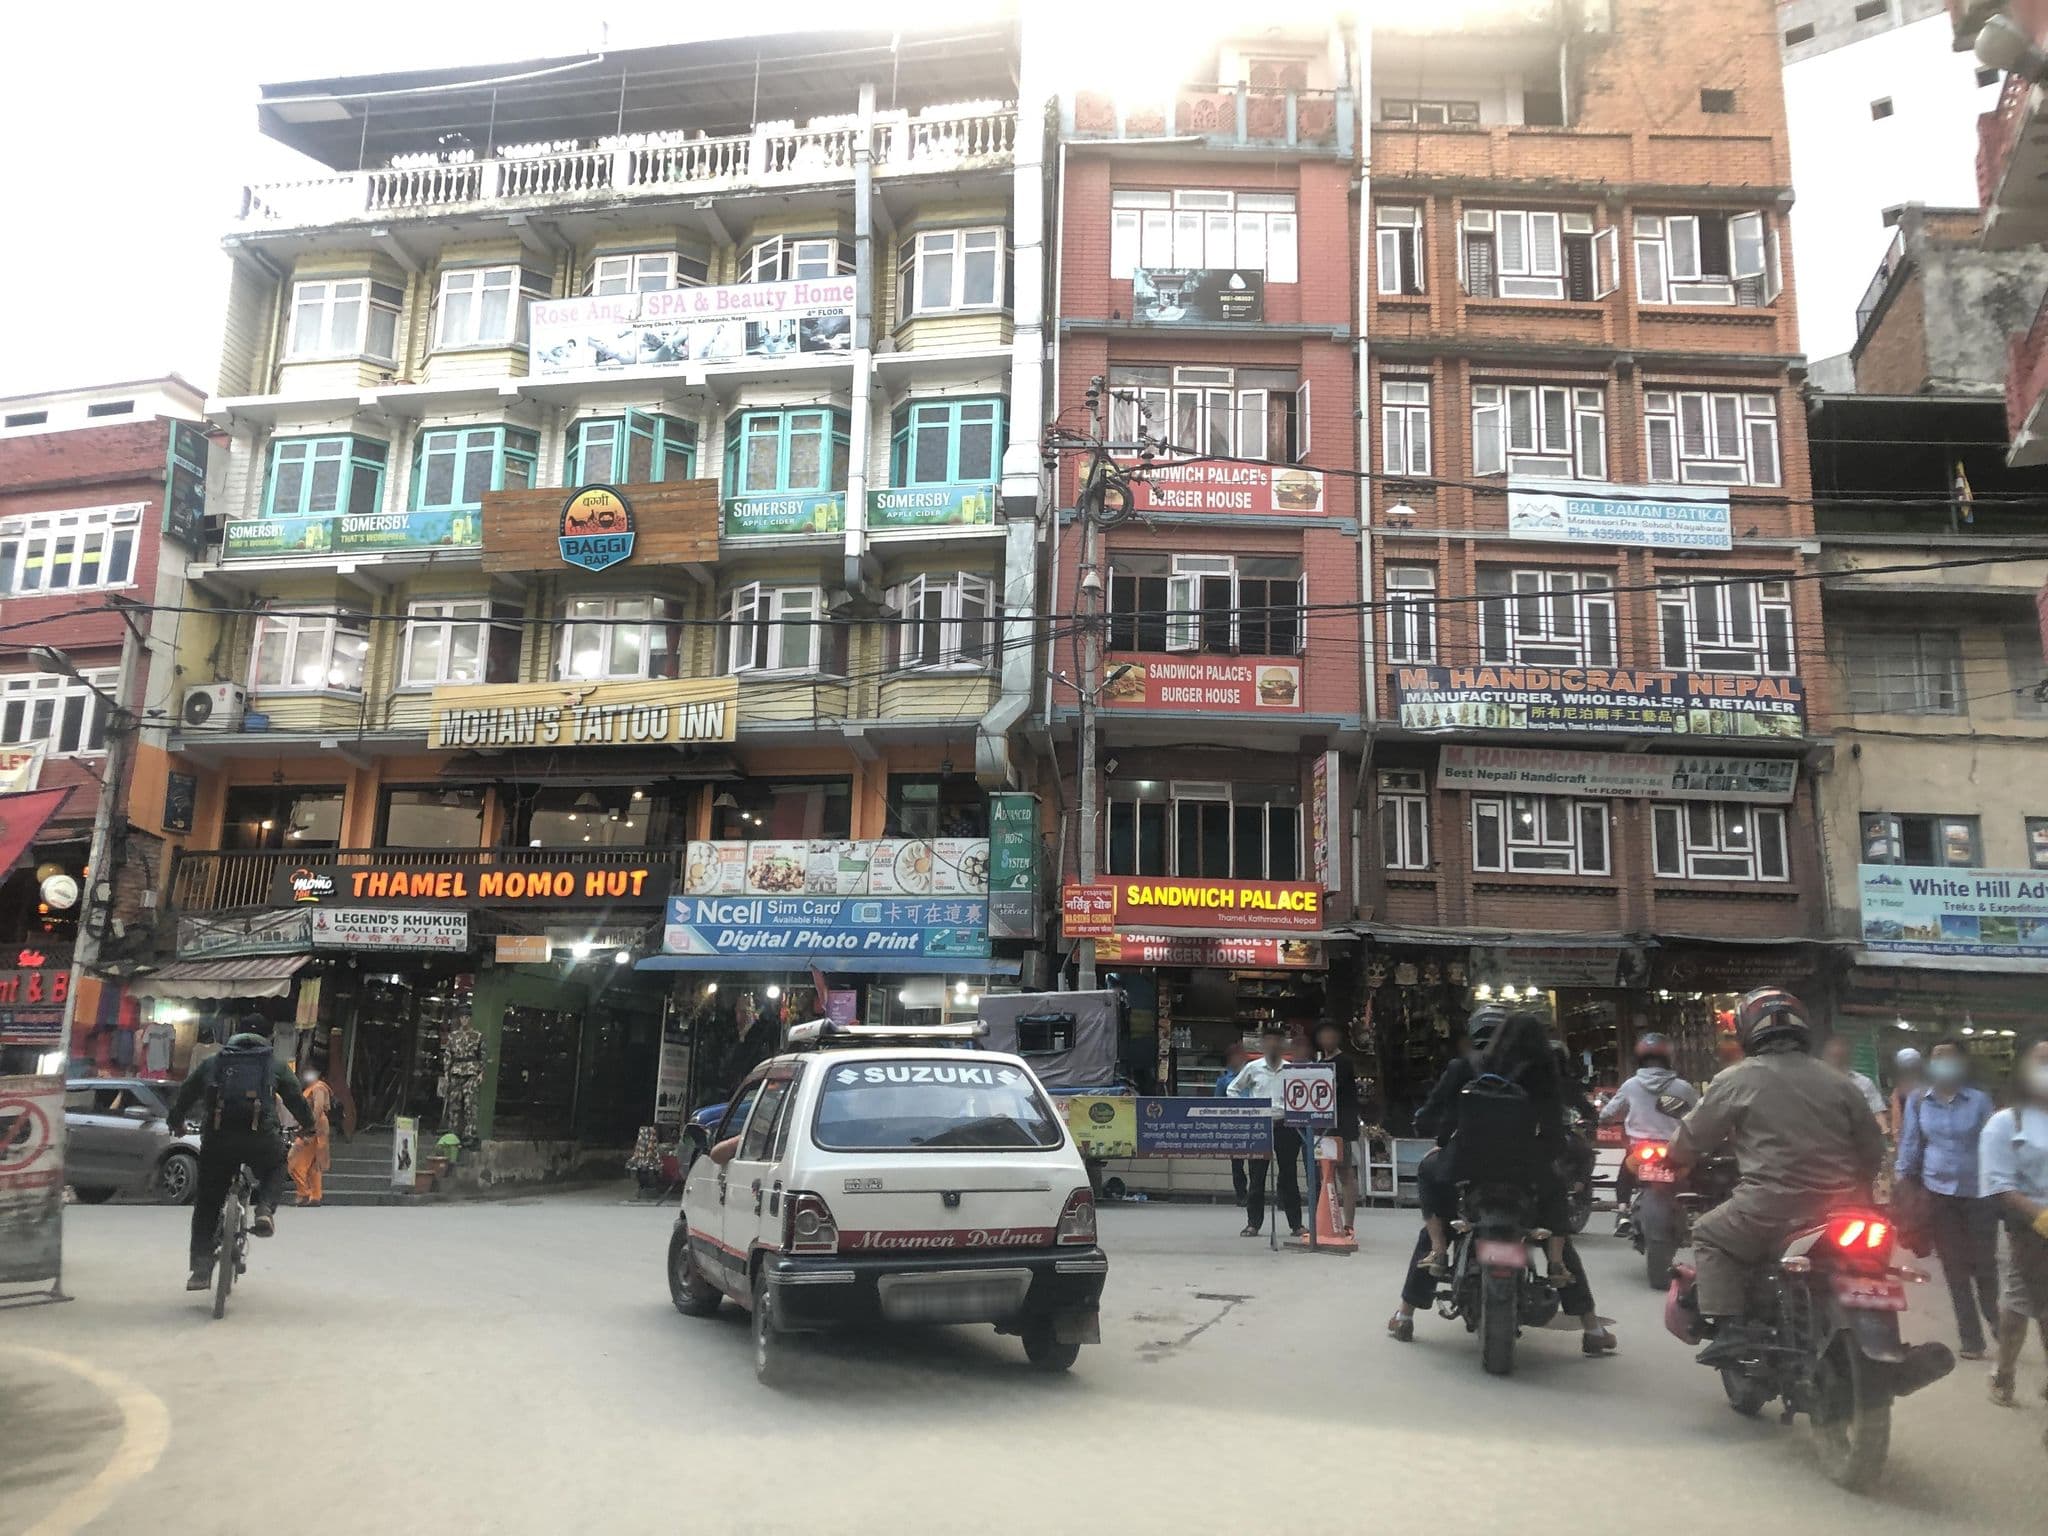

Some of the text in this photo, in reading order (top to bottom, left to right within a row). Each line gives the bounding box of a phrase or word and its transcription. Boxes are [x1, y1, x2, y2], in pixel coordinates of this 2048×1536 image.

[534, 305, 583, 326] Rose
[648, 294, 687, 315] SPA
[694, 291, 710, 310] &
[716, 287, 787, 313] Beauty
[793, 283, 855, 303] Home
[818, 307, 844, 316] FLOOR
[1208, 467, 1268, 486] PALACE's
[1148, 489, 1252, 509] BURGER HOUSE
[915, 509, 942, 518] CIDER
[1568, 501, 1725, 521] BAL RAMAN BATIKA
[341, 514, 410, 532] SOMERSBY.
[742, 518, 795, 527] APPLE CIDER
[565, 538, 626, 556] BAGGI
[584, 554, 609, 565] BAR
[1150, 663, 1253, 682] SANDWICH PALACE's
[1399, 668, 1801, 701] M. HANDICRAFT NEPAL
[1161, 687, 1241, 704] BURGER HOUSE
[1406, 690, 1796, 714] MANUFACTURER, WHOLESALER & RETAILER
[438, 701, 726, 745] MOHAN'S TATTOO INN
[1474, 750, 1601, 772] HANDICRAFT
[1445, 767, 1474, 778] Best
[1477, 769, 1518, 781] Nepali
[1520, 771, 1587, 784] Handicraft
[1600, 787, 1632, 795] FLOOR
[1001, 848, 1030, 868] SYSTEM
[351, 869, 648, 899] THAMEL MOMO HUT
[1909, 878, 1970, 897] White
[1976, 880, 2011, 898] Hill
[1127, 885, 1318, 912] SANDWICH PALACE
[1943, 900, 1976, 912] Treks
[1978, 902, 1986, 912] &
[334, 913, 467, 927] LEGEND'S KHUKURI
[696, 899, 840, 925] Ncell Sim Card
[772, 915, 833, 925] Available Here
[1218, 913, 1317, 926] Thamel, Kathmandu, Nepal
[334, 925, 465, 936] GALLERY PVT. LTD.
[716, 929, 920, 952] Digital Photo Print
[1143, 947, 1256, 965] BURGER HOUSE
[864, 1066, 993, 1085] SUZUKI
[966, 1228, 1044, 1247] Dolma
